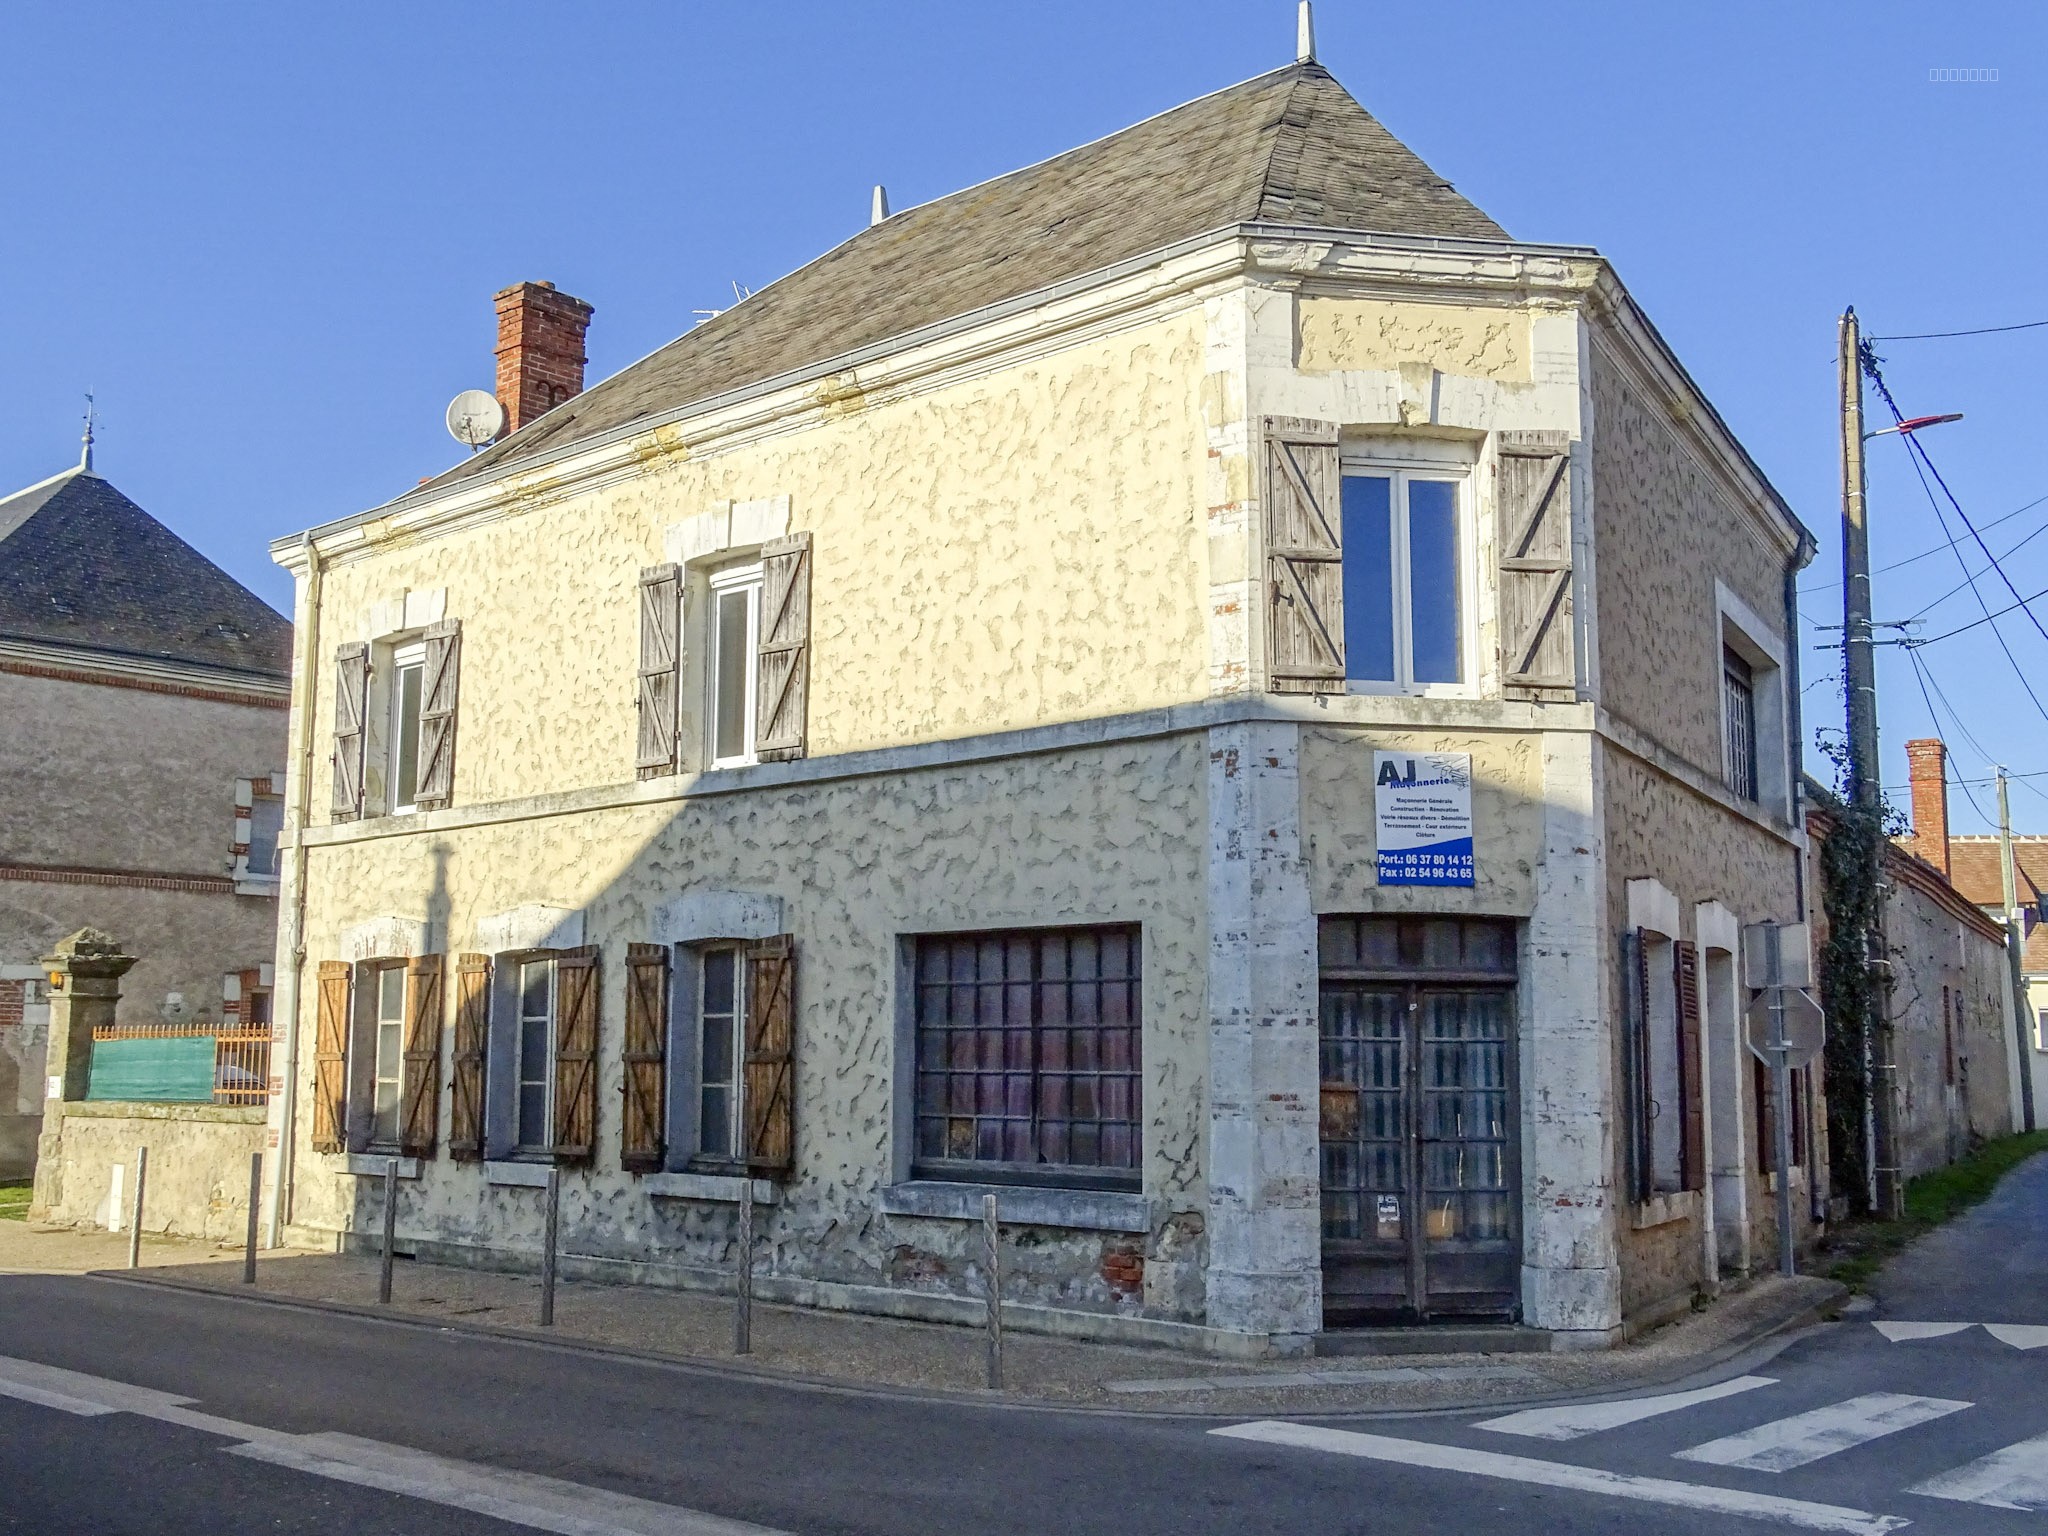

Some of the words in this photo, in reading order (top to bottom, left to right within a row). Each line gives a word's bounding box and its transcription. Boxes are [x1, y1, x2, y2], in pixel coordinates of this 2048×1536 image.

[1377, 760, 1416, 785] AJ
[1390, 777, 1450, 790] Maçonnerie
[1406, 854, 1418, 864] 06
[1419, 854, 1431, 865] 37
[1433, 855, 1445, 865] 80
[1447, 855, 1459, 865] 14
[1461, 855, 1473, 865] 12
[1380, 867, 1397, 877] Fax
[1405, 867, 1417, 877] 02
[1418, 867, 1430, 878] 54
[1432, 868, 1444, 878] 96
[1446, 868, 1458, 878] 43
[1460, 868, 1472, 878] 65
